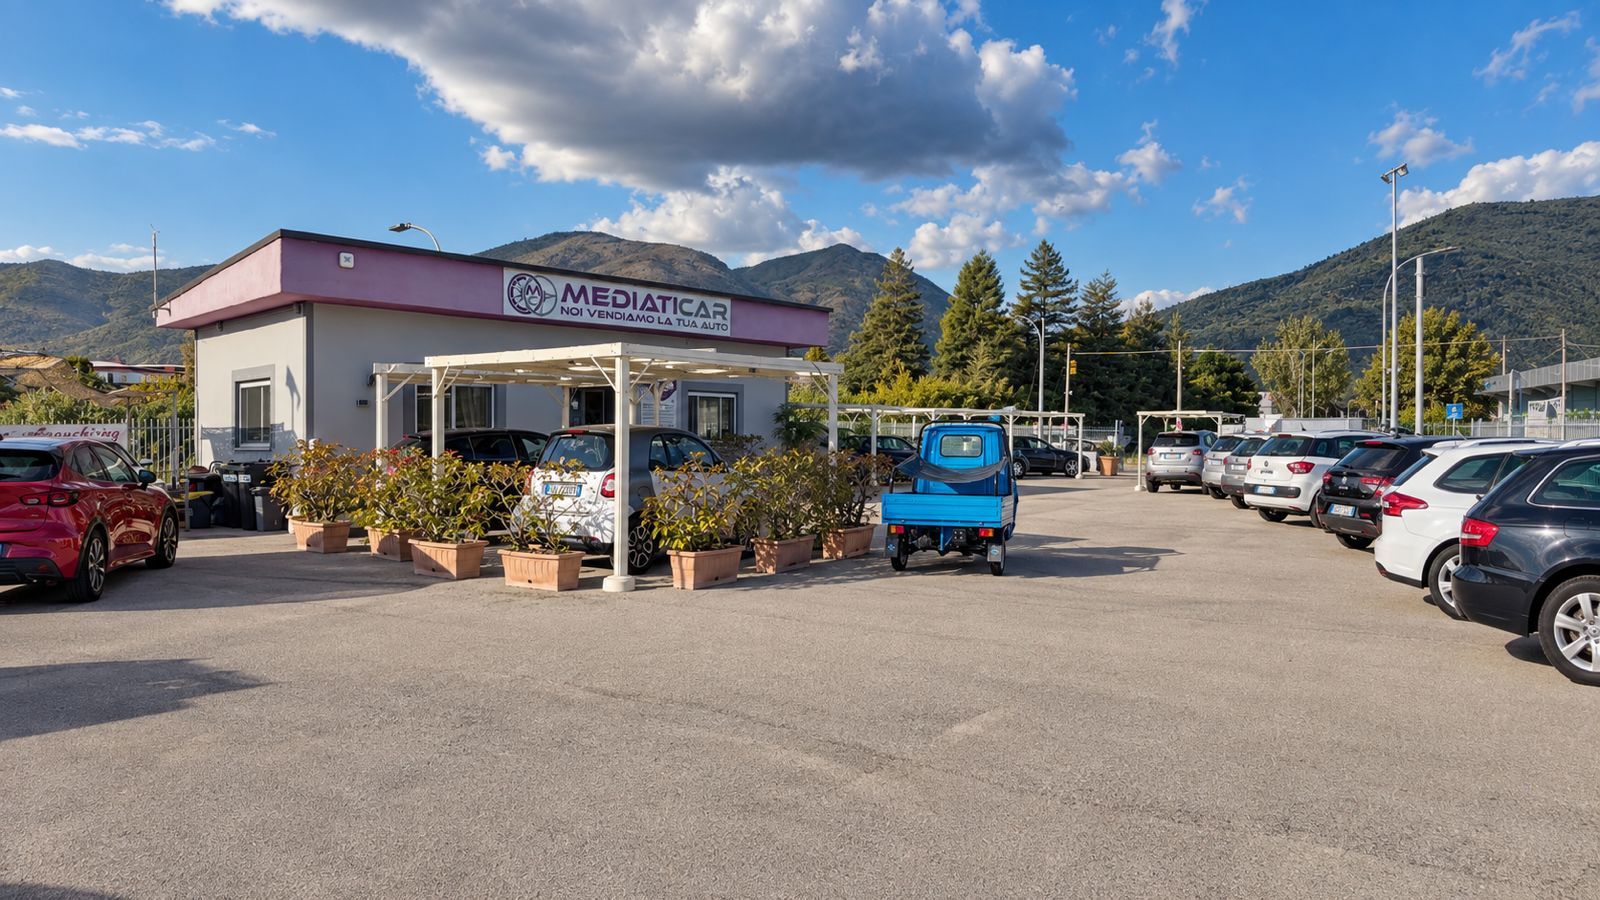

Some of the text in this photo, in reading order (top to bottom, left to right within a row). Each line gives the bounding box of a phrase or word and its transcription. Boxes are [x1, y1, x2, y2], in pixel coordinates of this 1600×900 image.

[526, 284, 541, 296] M
[561, 283, 728, 321] MEDIATICAR
[560, 306, 729, 332] NOI VENDIAMO LA TUA AUTO
